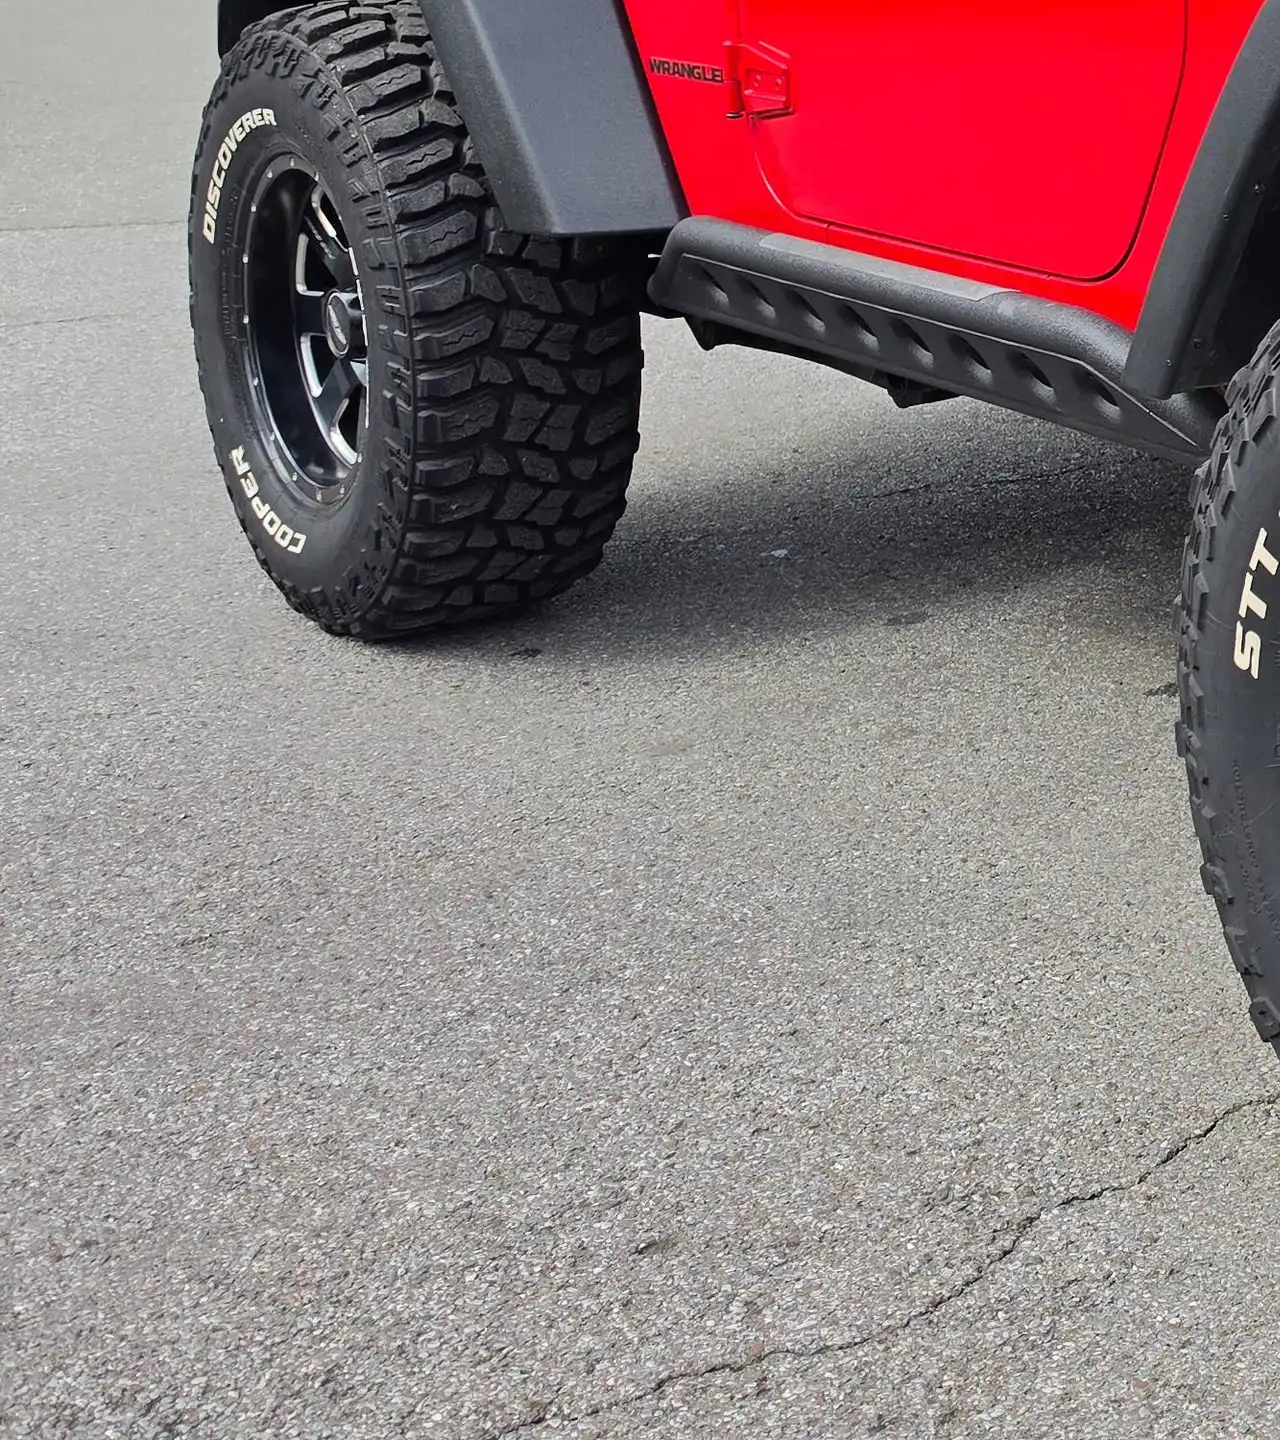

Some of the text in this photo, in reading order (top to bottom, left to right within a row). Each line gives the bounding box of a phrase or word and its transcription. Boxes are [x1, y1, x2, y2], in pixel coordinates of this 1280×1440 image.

[203, 107, 277, 244] DISCOVERER
[229, 444, 306, 554] COOPER
[1232, 527, 1280, 680] STT
